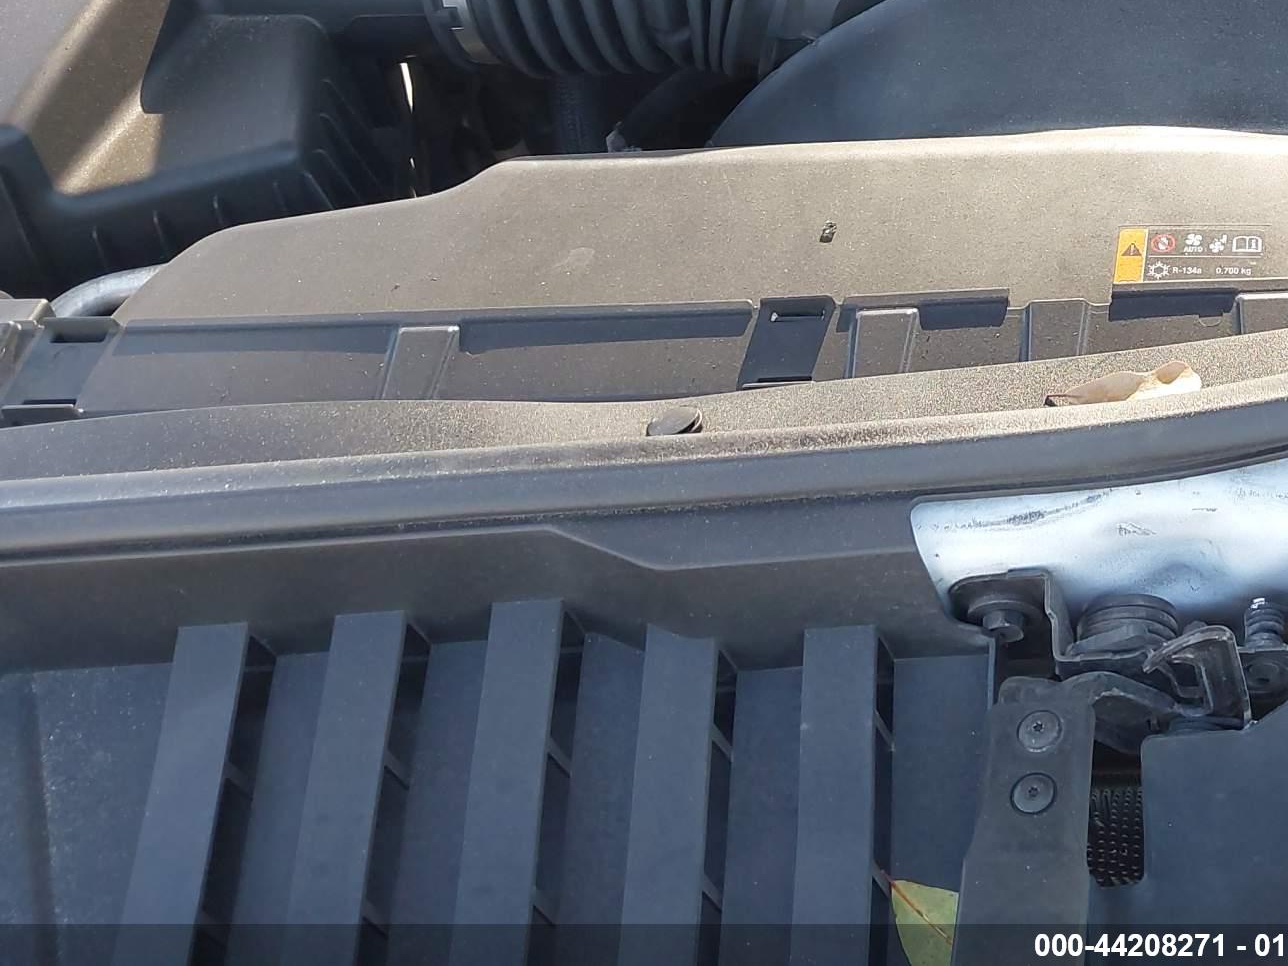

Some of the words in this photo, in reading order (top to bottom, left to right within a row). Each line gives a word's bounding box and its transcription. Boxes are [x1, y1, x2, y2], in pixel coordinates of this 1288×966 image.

[1172, 266, 1202, 274] R-134a
[1216, 266, 1239, 275] 0.700
[1241, 266, 1252, 276] kg
